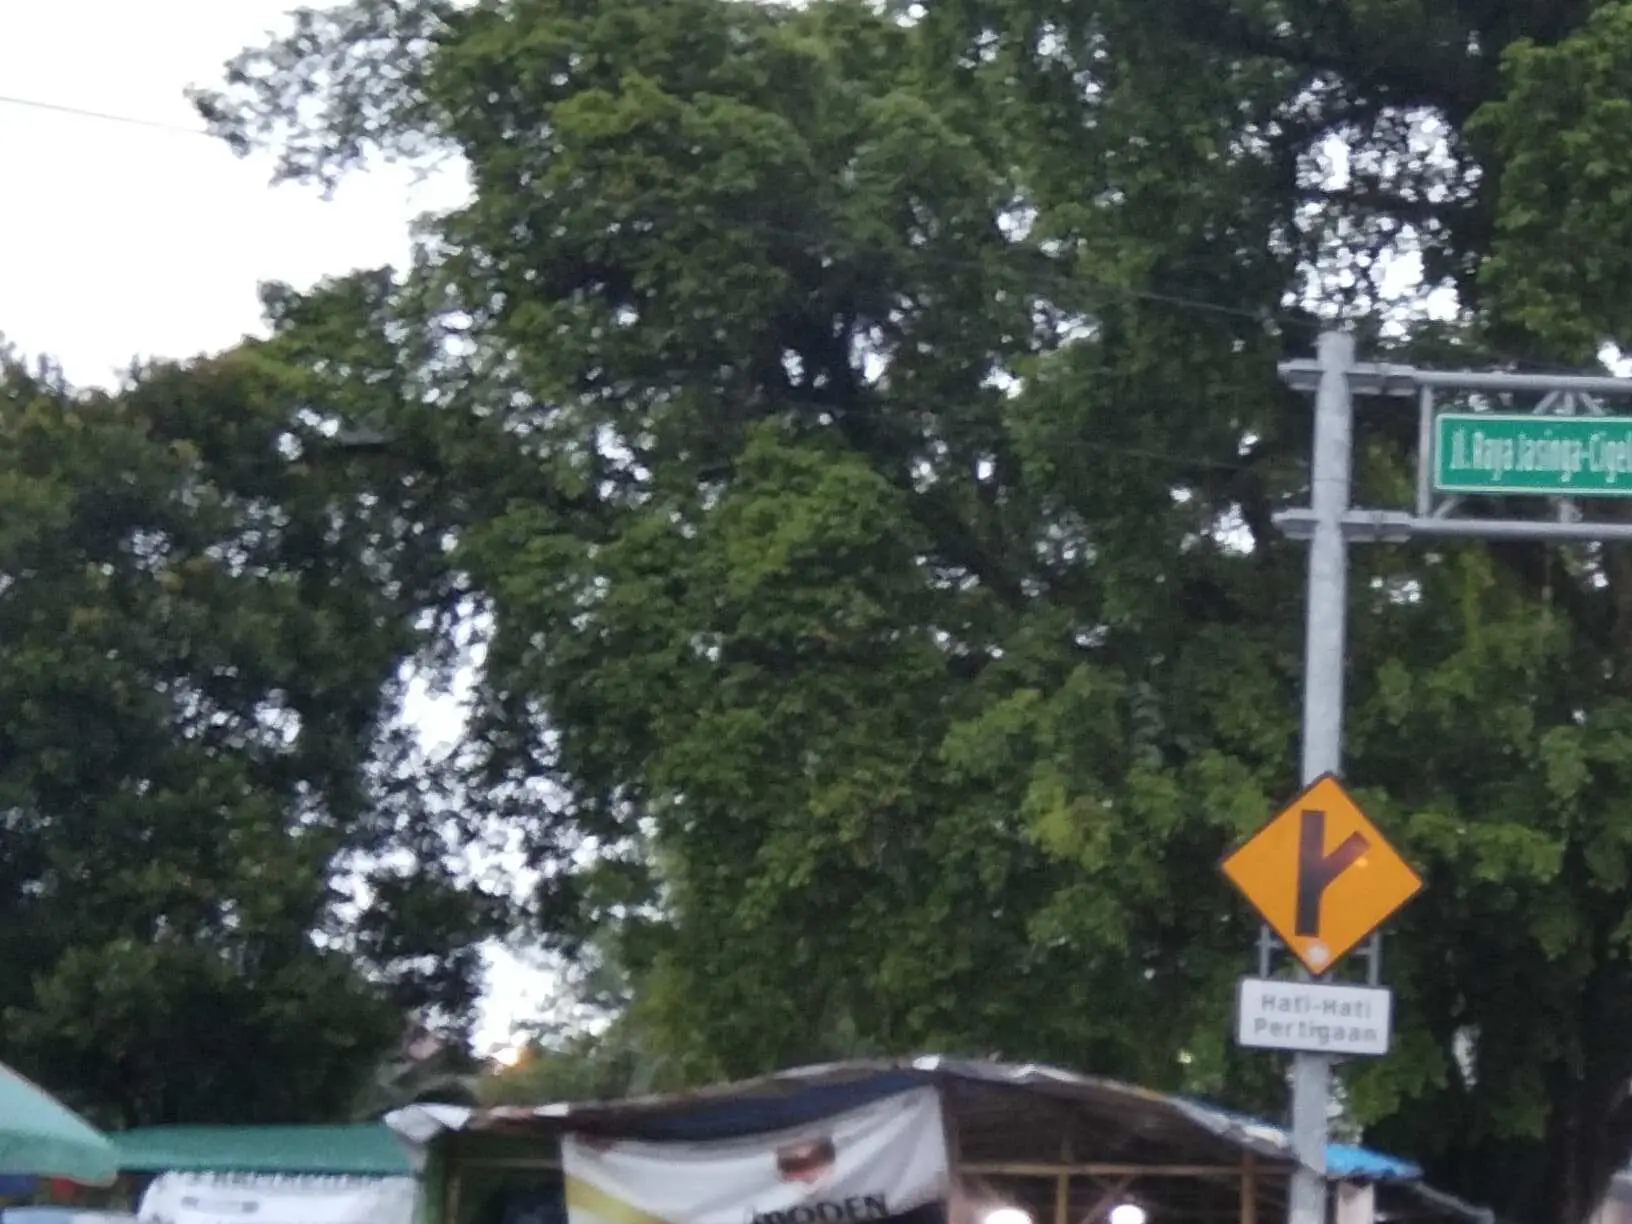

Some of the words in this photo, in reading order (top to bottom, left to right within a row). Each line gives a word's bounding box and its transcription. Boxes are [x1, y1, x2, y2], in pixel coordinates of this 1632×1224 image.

[1472, 431, 1514, 481] Raya
[1261, 994, 1373, 1020] Hati-Hati
[1253, 1017, 1379, 1046] Pertigaan
